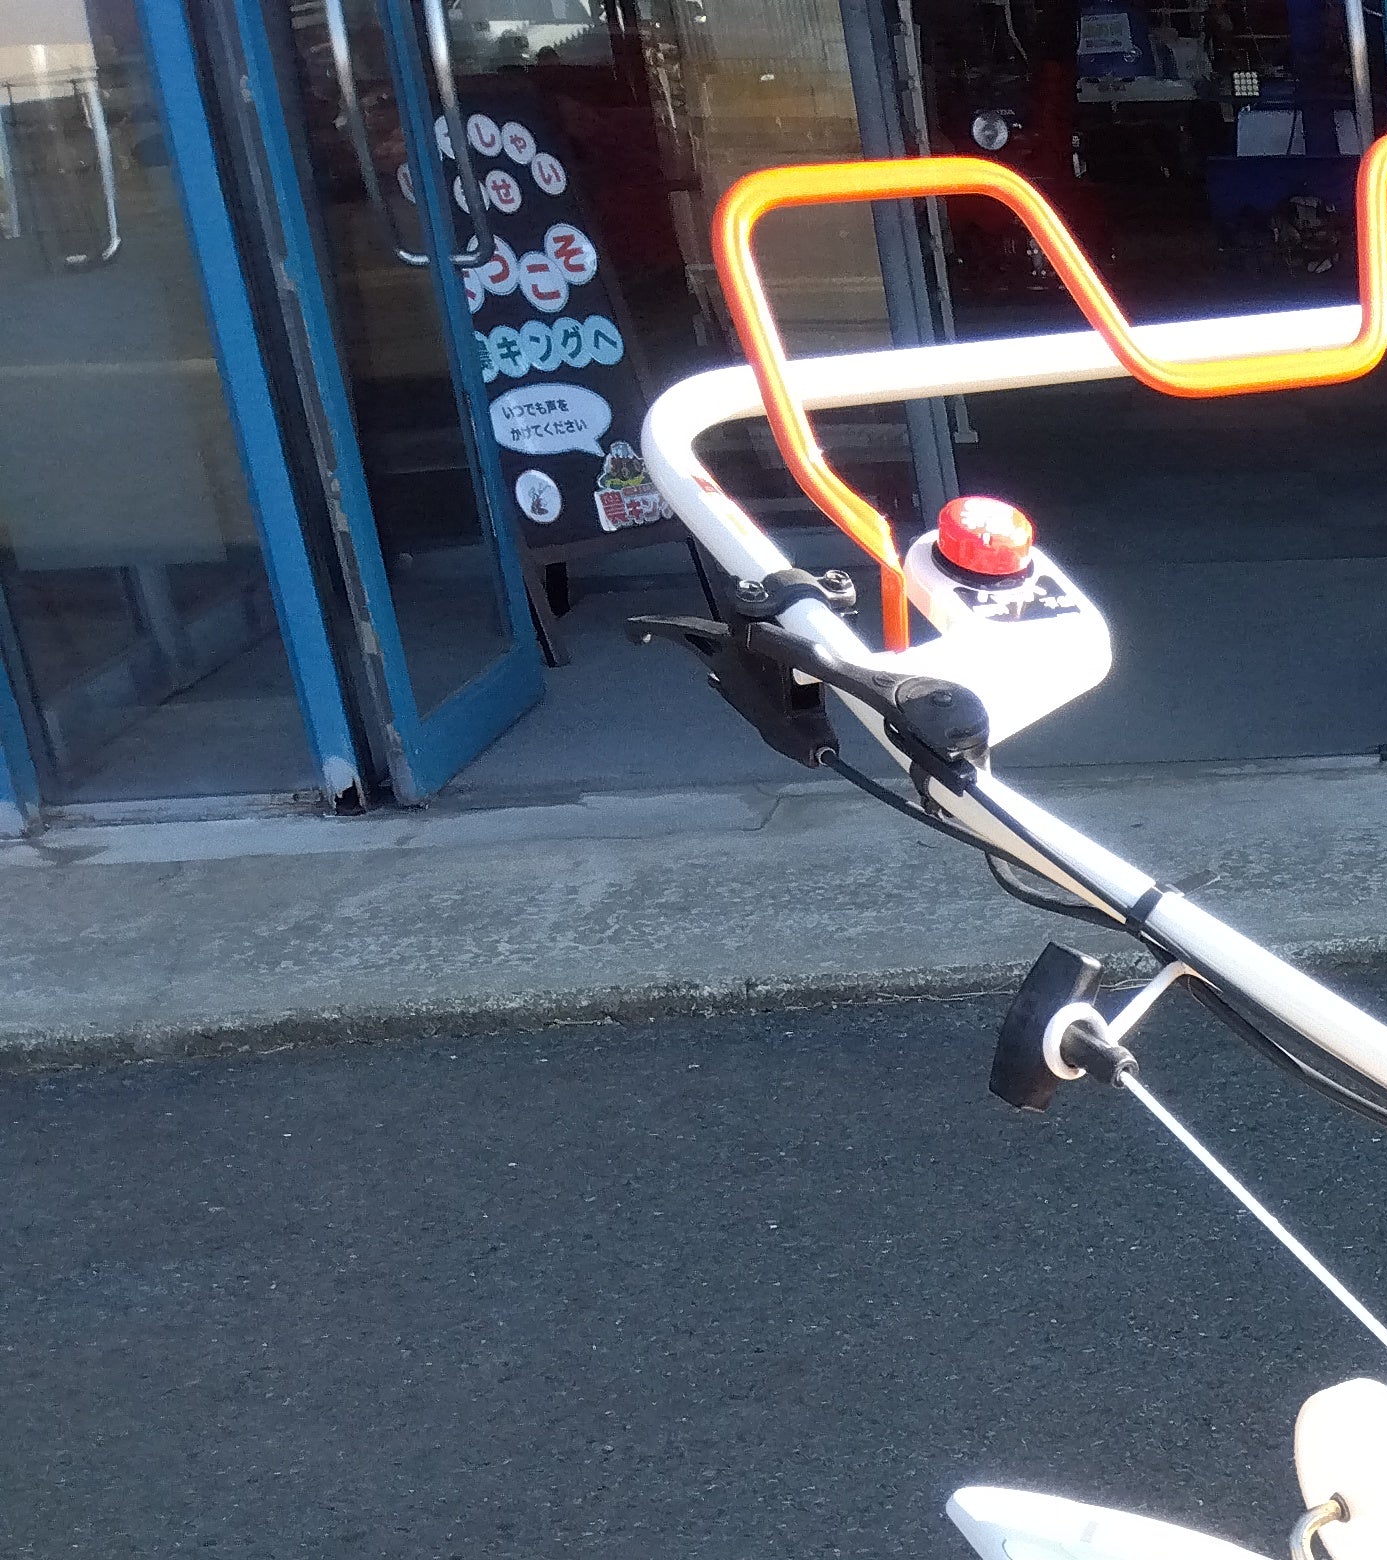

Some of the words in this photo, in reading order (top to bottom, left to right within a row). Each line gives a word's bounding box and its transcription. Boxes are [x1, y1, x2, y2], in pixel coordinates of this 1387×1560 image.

[502, 399, 570, 419] いつでも声を
[511, 419, 588, 441] かけてください
